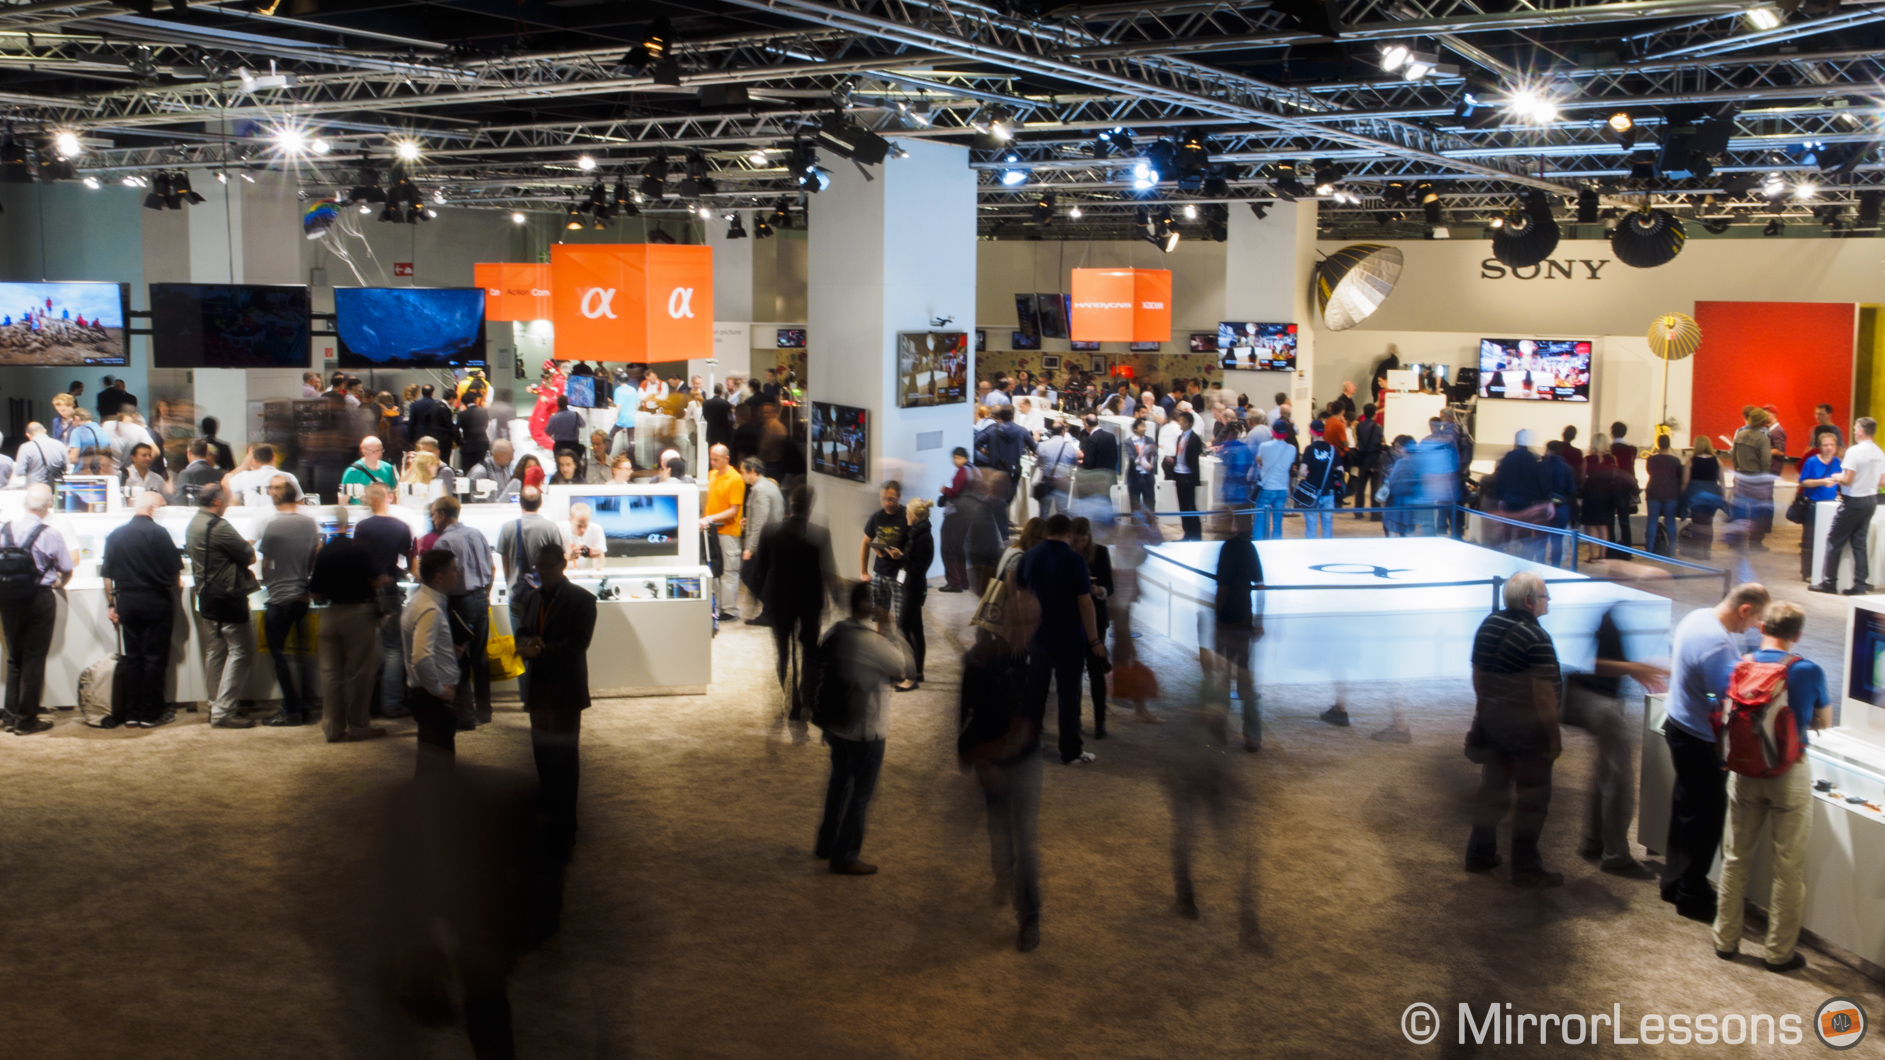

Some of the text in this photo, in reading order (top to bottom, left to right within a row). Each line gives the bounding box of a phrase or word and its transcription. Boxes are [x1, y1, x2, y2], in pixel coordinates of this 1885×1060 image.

[1481, 258, 1611, 280] SONY
[531, 288, 550, 296] Cam
[581, 287, 618, 319] α
[668, 287, 695, 319] α
